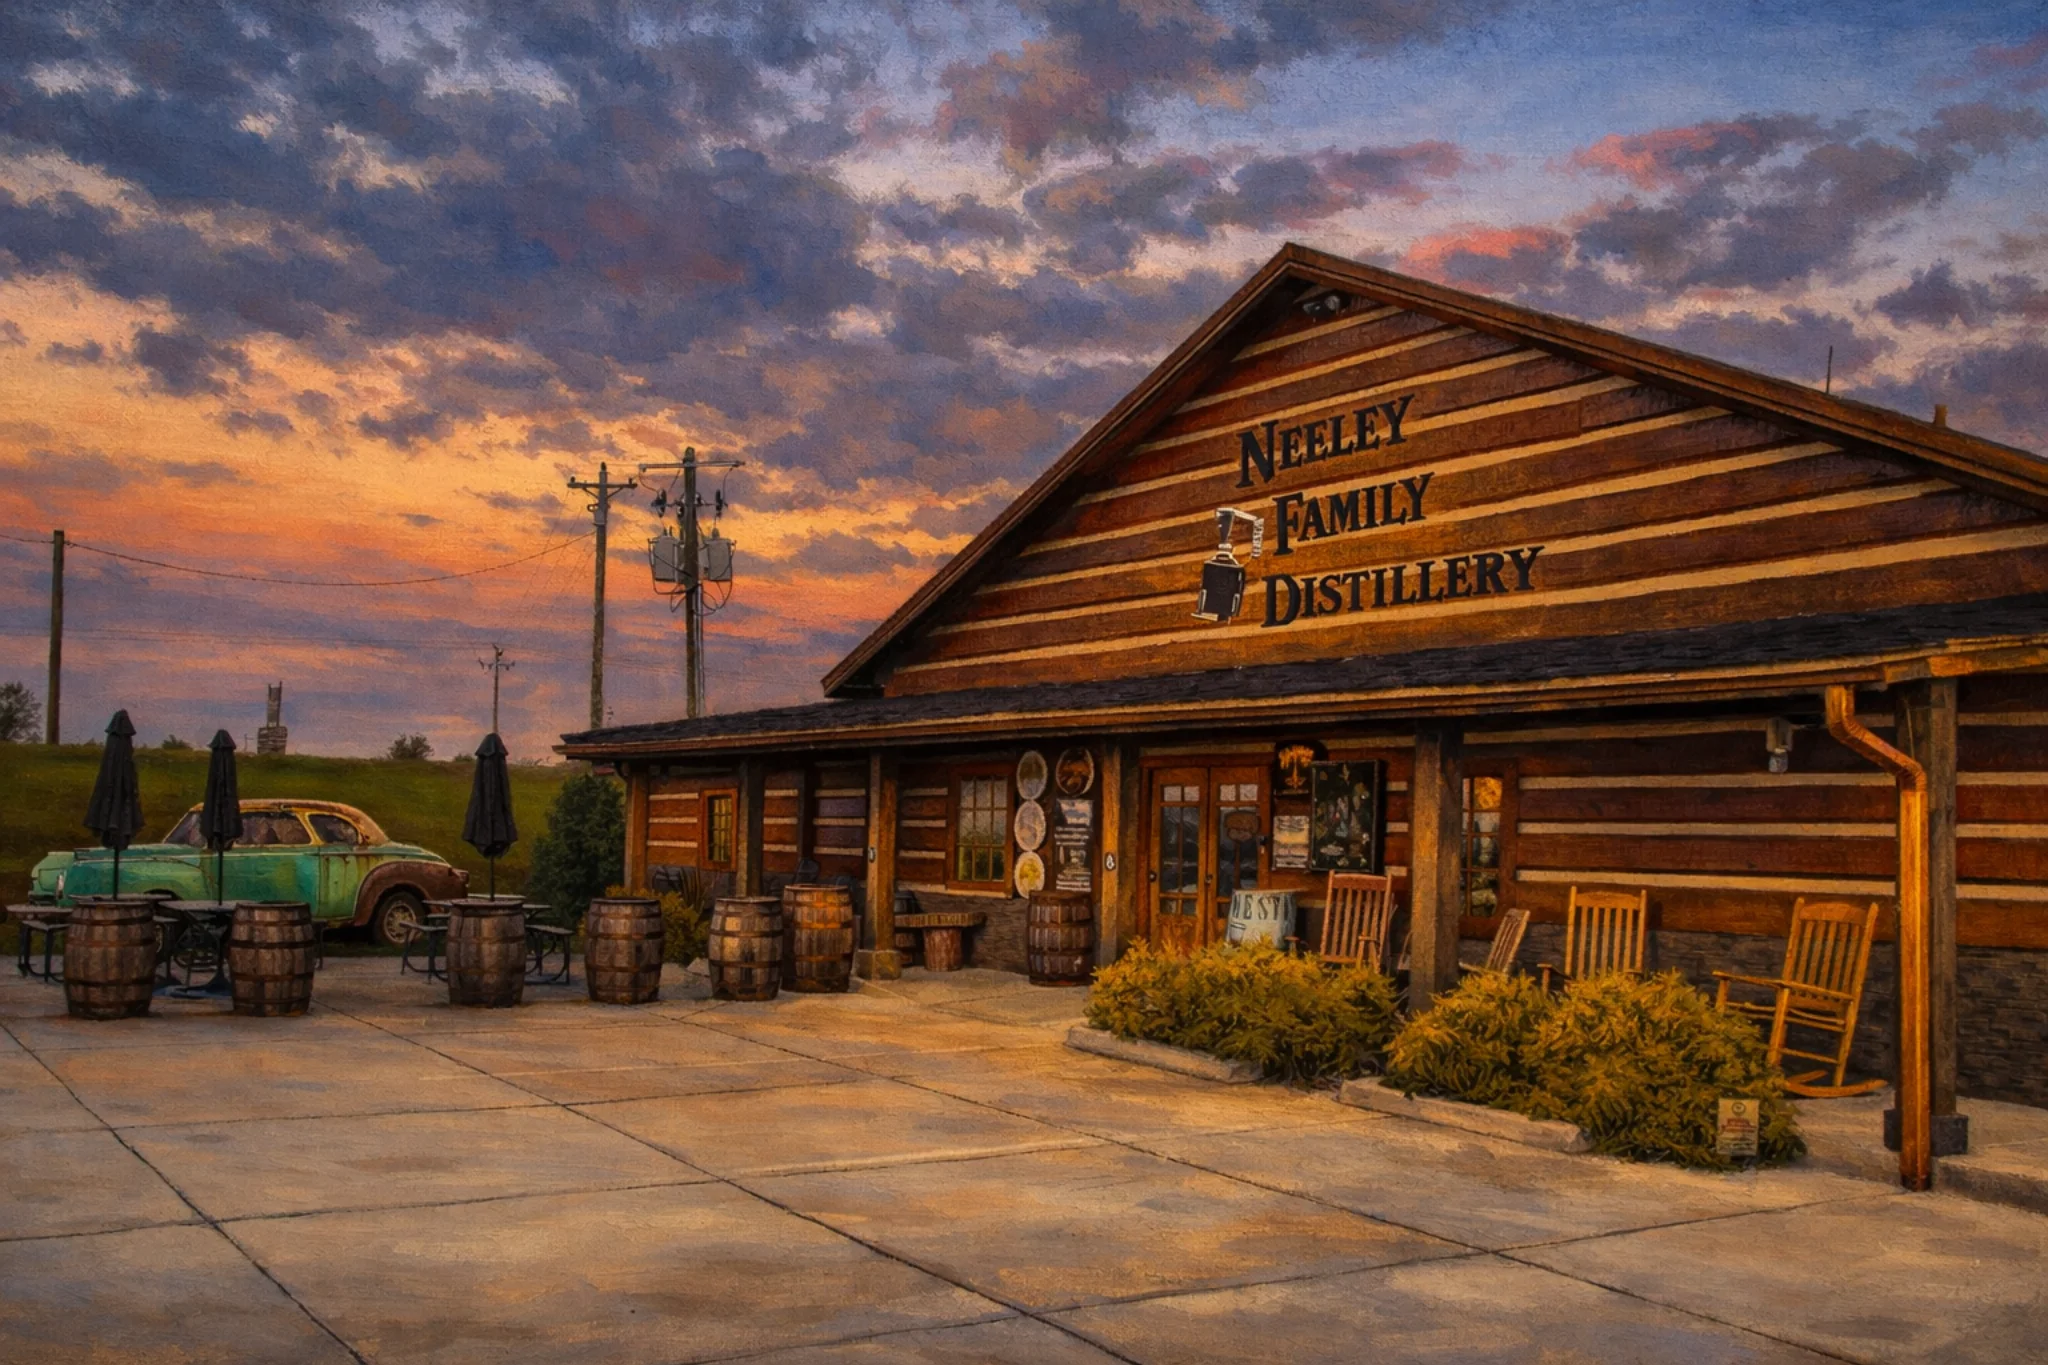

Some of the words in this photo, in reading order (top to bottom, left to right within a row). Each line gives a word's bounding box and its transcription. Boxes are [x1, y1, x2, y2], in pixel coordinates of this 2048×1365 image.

[1235, 393, 1416, 489] NEELEY
[1272, 472, 1435, 556] FAMILY
[1261, 546, 1546, 628] DISTILLERY
